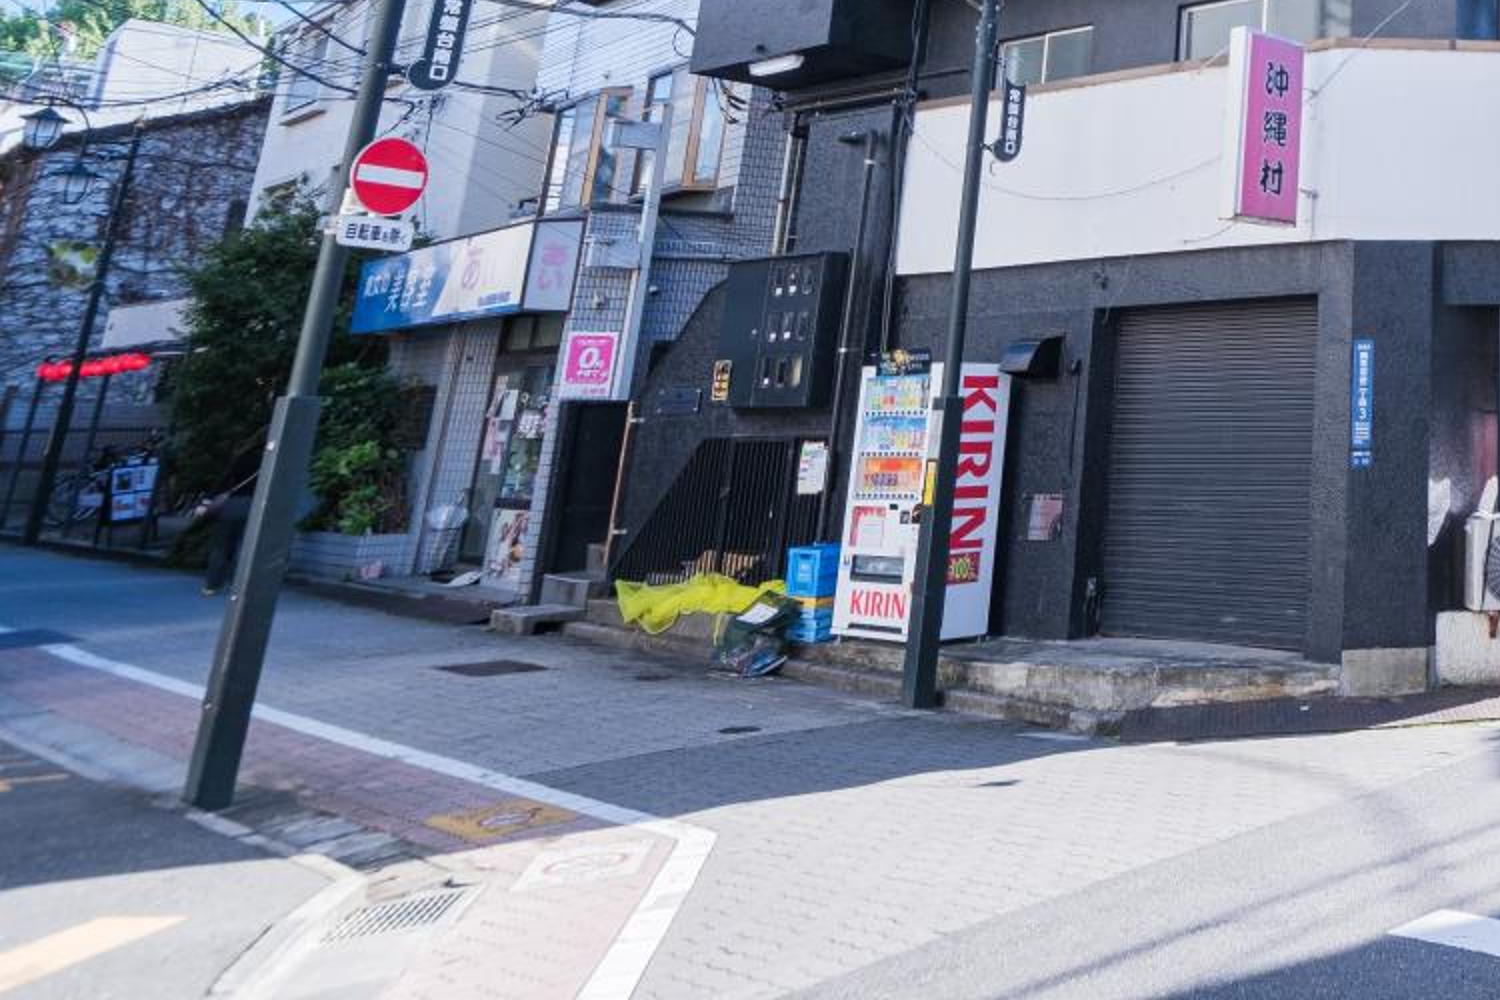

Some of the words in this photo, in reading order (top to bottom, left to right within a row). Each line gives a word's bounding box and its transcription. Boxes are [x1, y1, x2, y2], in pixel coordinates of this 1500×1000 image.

[1260, 62, 1289, 196] 沖縄村
[345, 222, 406, 245] 自転車を除く
[950, 375, 999, 549] KIRIN
[850, 589, 906, 620] KIRIN
